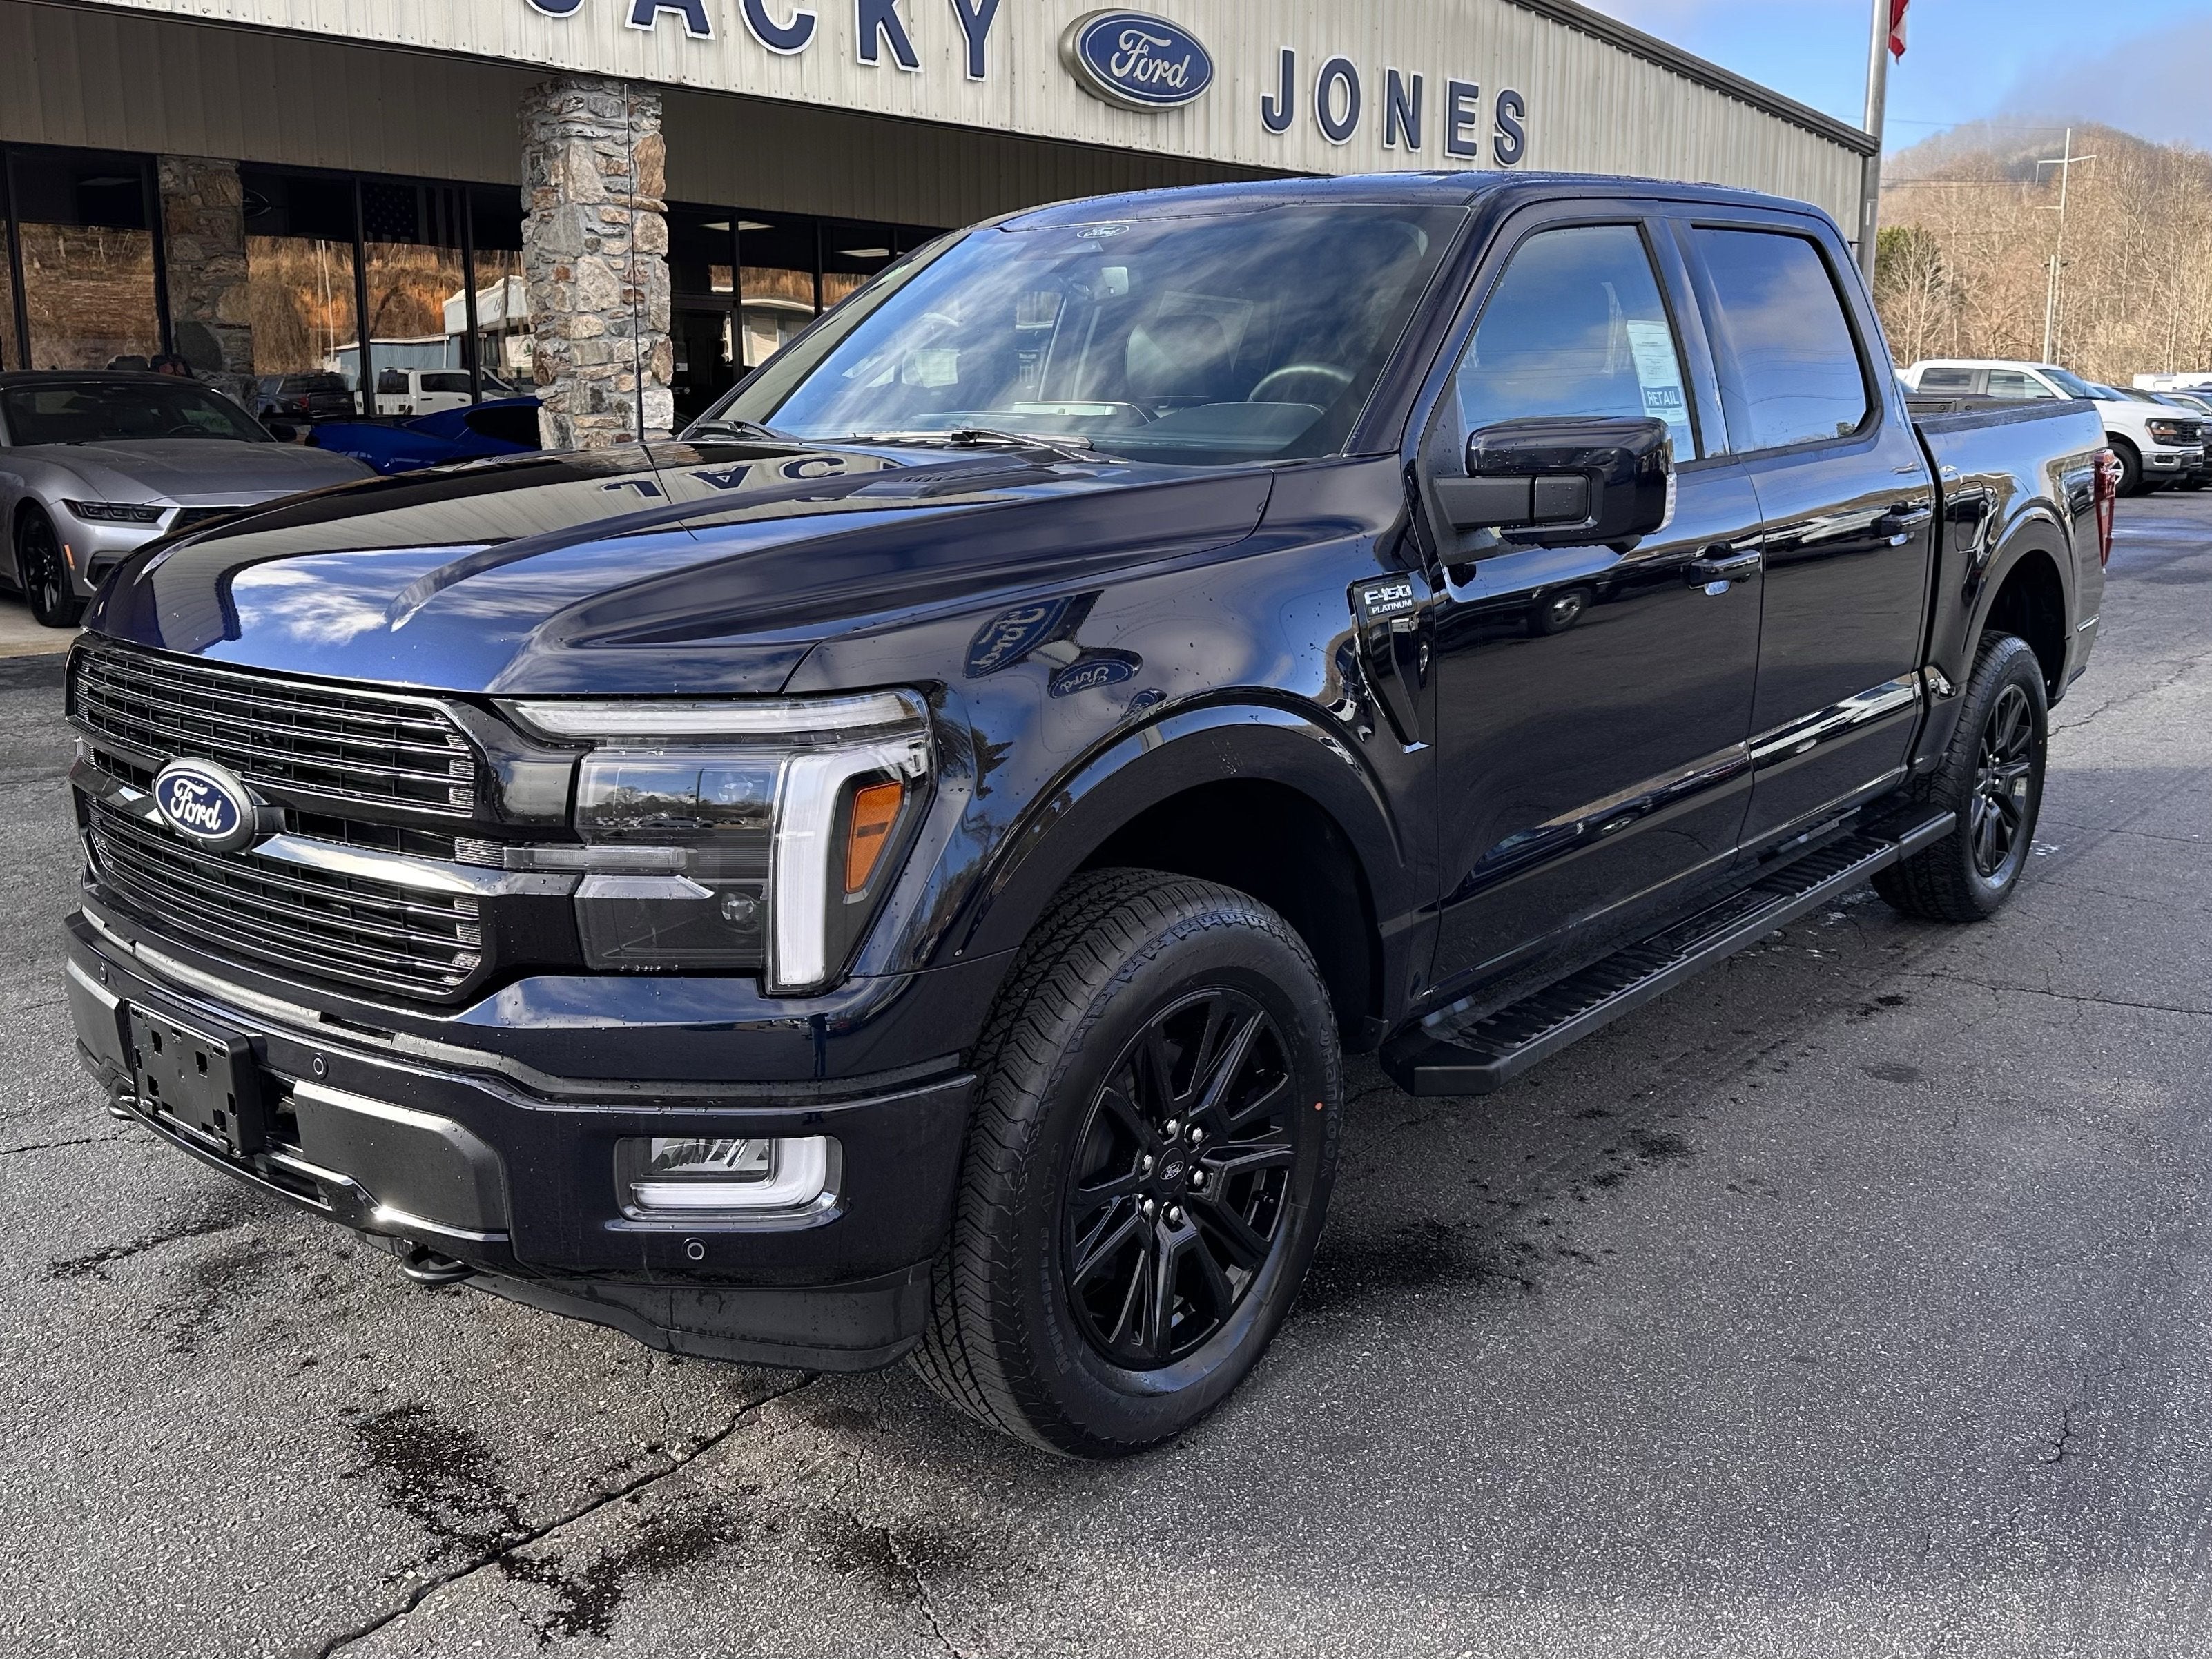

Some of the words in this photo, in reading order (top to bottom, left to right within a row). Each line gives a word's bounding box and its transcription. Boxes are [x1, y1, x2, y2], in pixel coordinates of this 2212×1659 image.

[1110, 29, 1191, 88] Ford
[1260, 46, 1526, 167] JONES
[1647, 391, 1680, 405] RETAIL
[1364, 585, 1413, 605] F-150
[1372, 599, 1413, 614] PLATINUM
[170, 778, 222, 830] Ford
